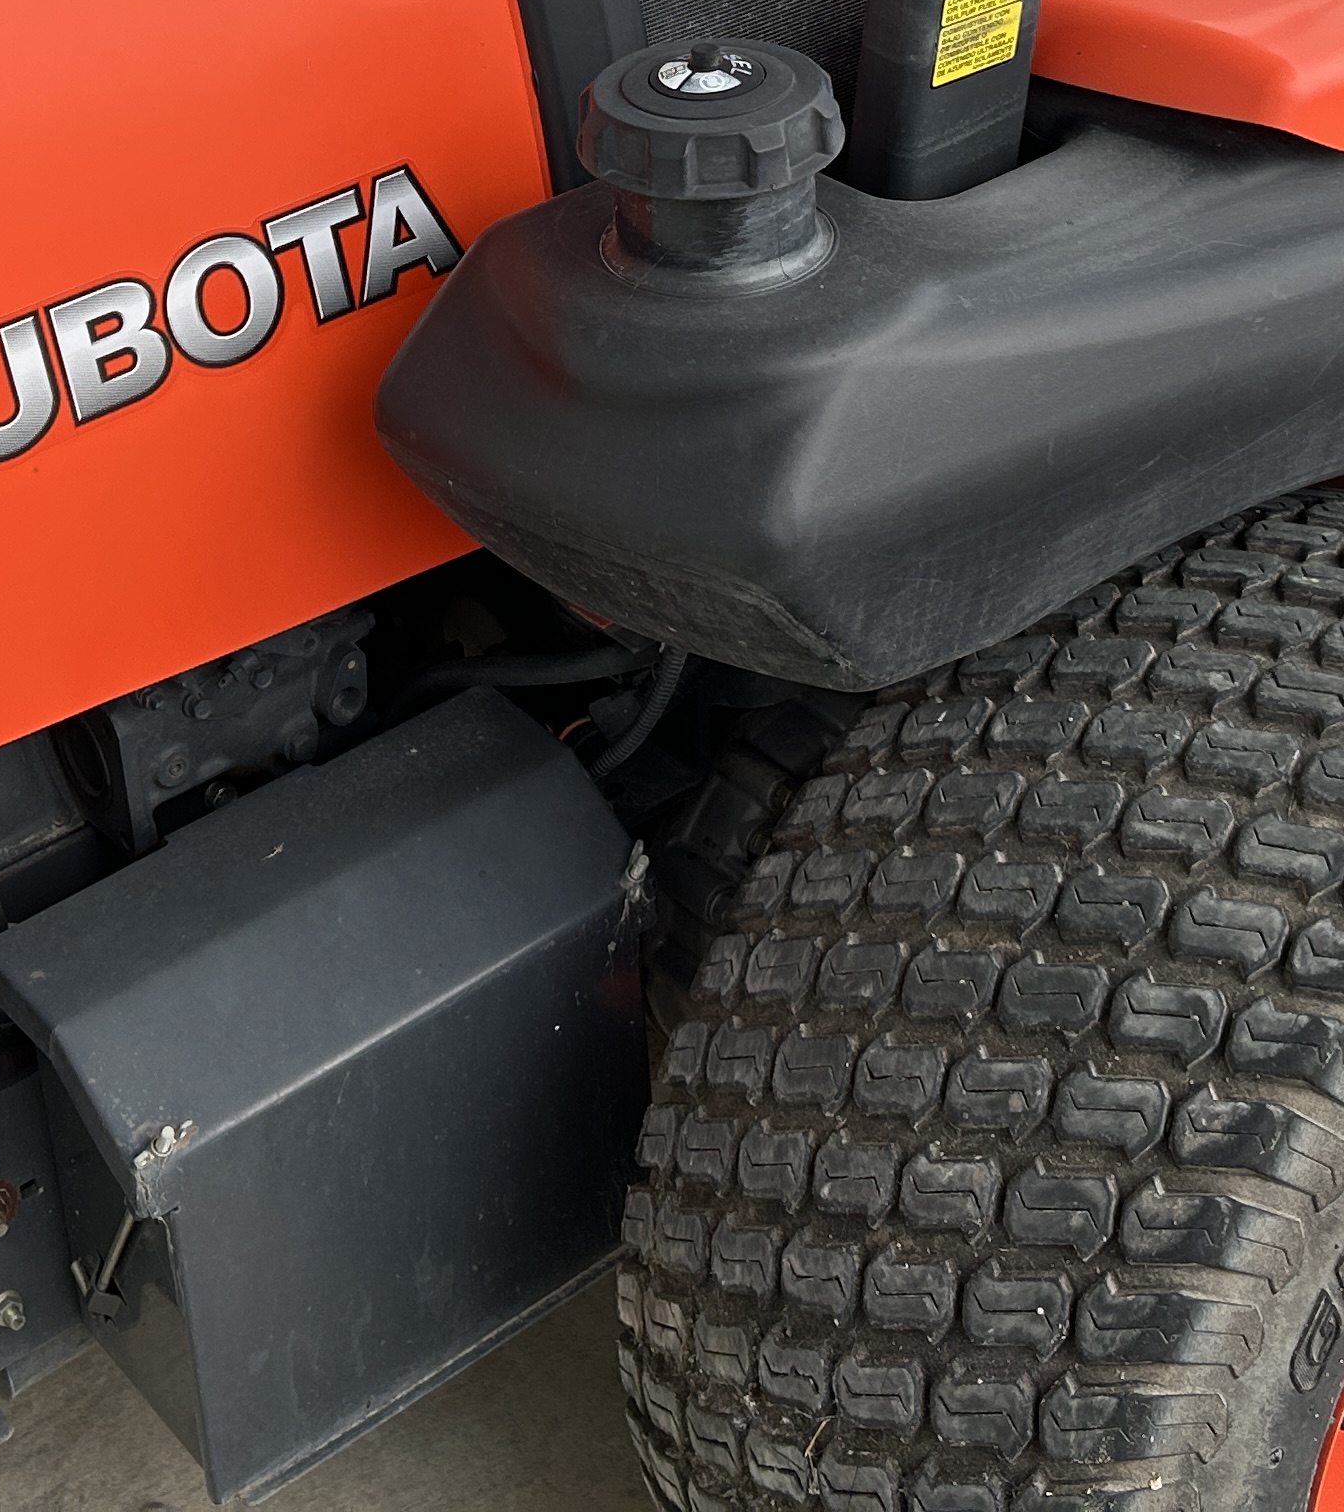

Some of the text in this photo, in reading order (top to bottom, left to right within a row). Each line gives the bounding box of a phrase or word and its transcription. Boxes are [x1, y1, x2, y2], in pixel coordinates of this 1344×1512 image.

[945, 6, 976, 23] SULFUR
[978, 0, 997, 11] FUEL
[946, 5, 959, 15] OR
